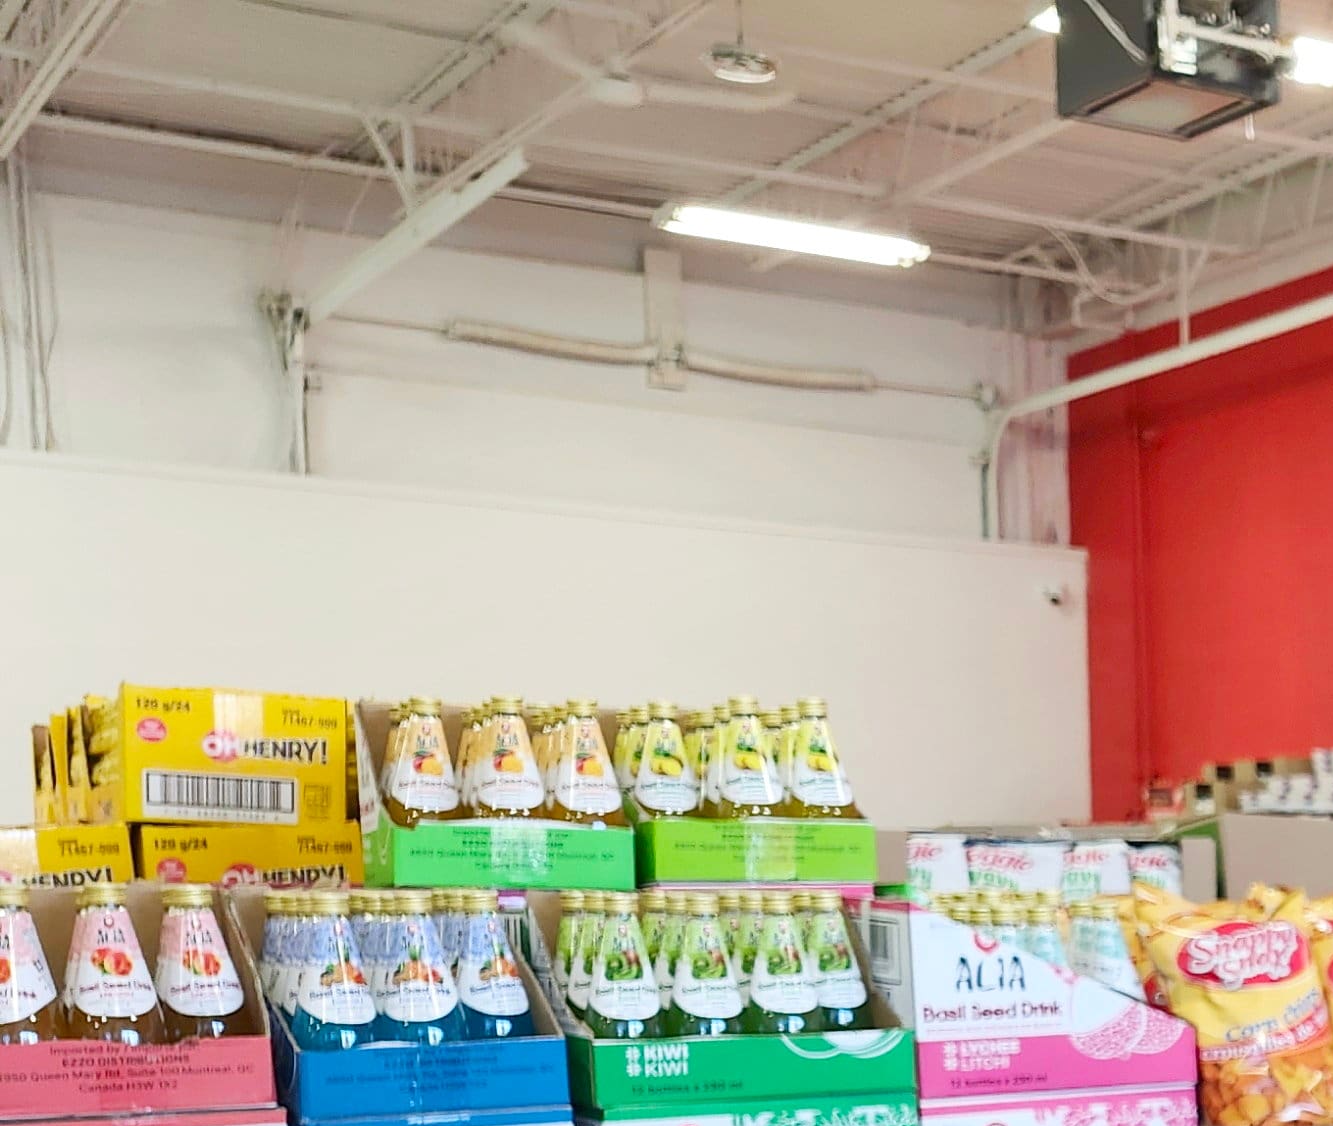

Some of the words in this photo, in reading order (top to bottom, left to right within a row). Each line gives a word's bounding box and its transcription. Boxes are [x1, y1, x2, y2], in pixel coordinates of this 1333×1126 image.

[136, 697, 159, 710] 120
[244, 739, 327, 765] HENRY!
[154, 838, 177, 851] 120
[954, 955, 1027, 994] ALIA
[972, 1001, 1017, 1019] Seed
[643, 1043, 689, 1062] KIWI
[645, 1061, 689, 1078] KIWI
